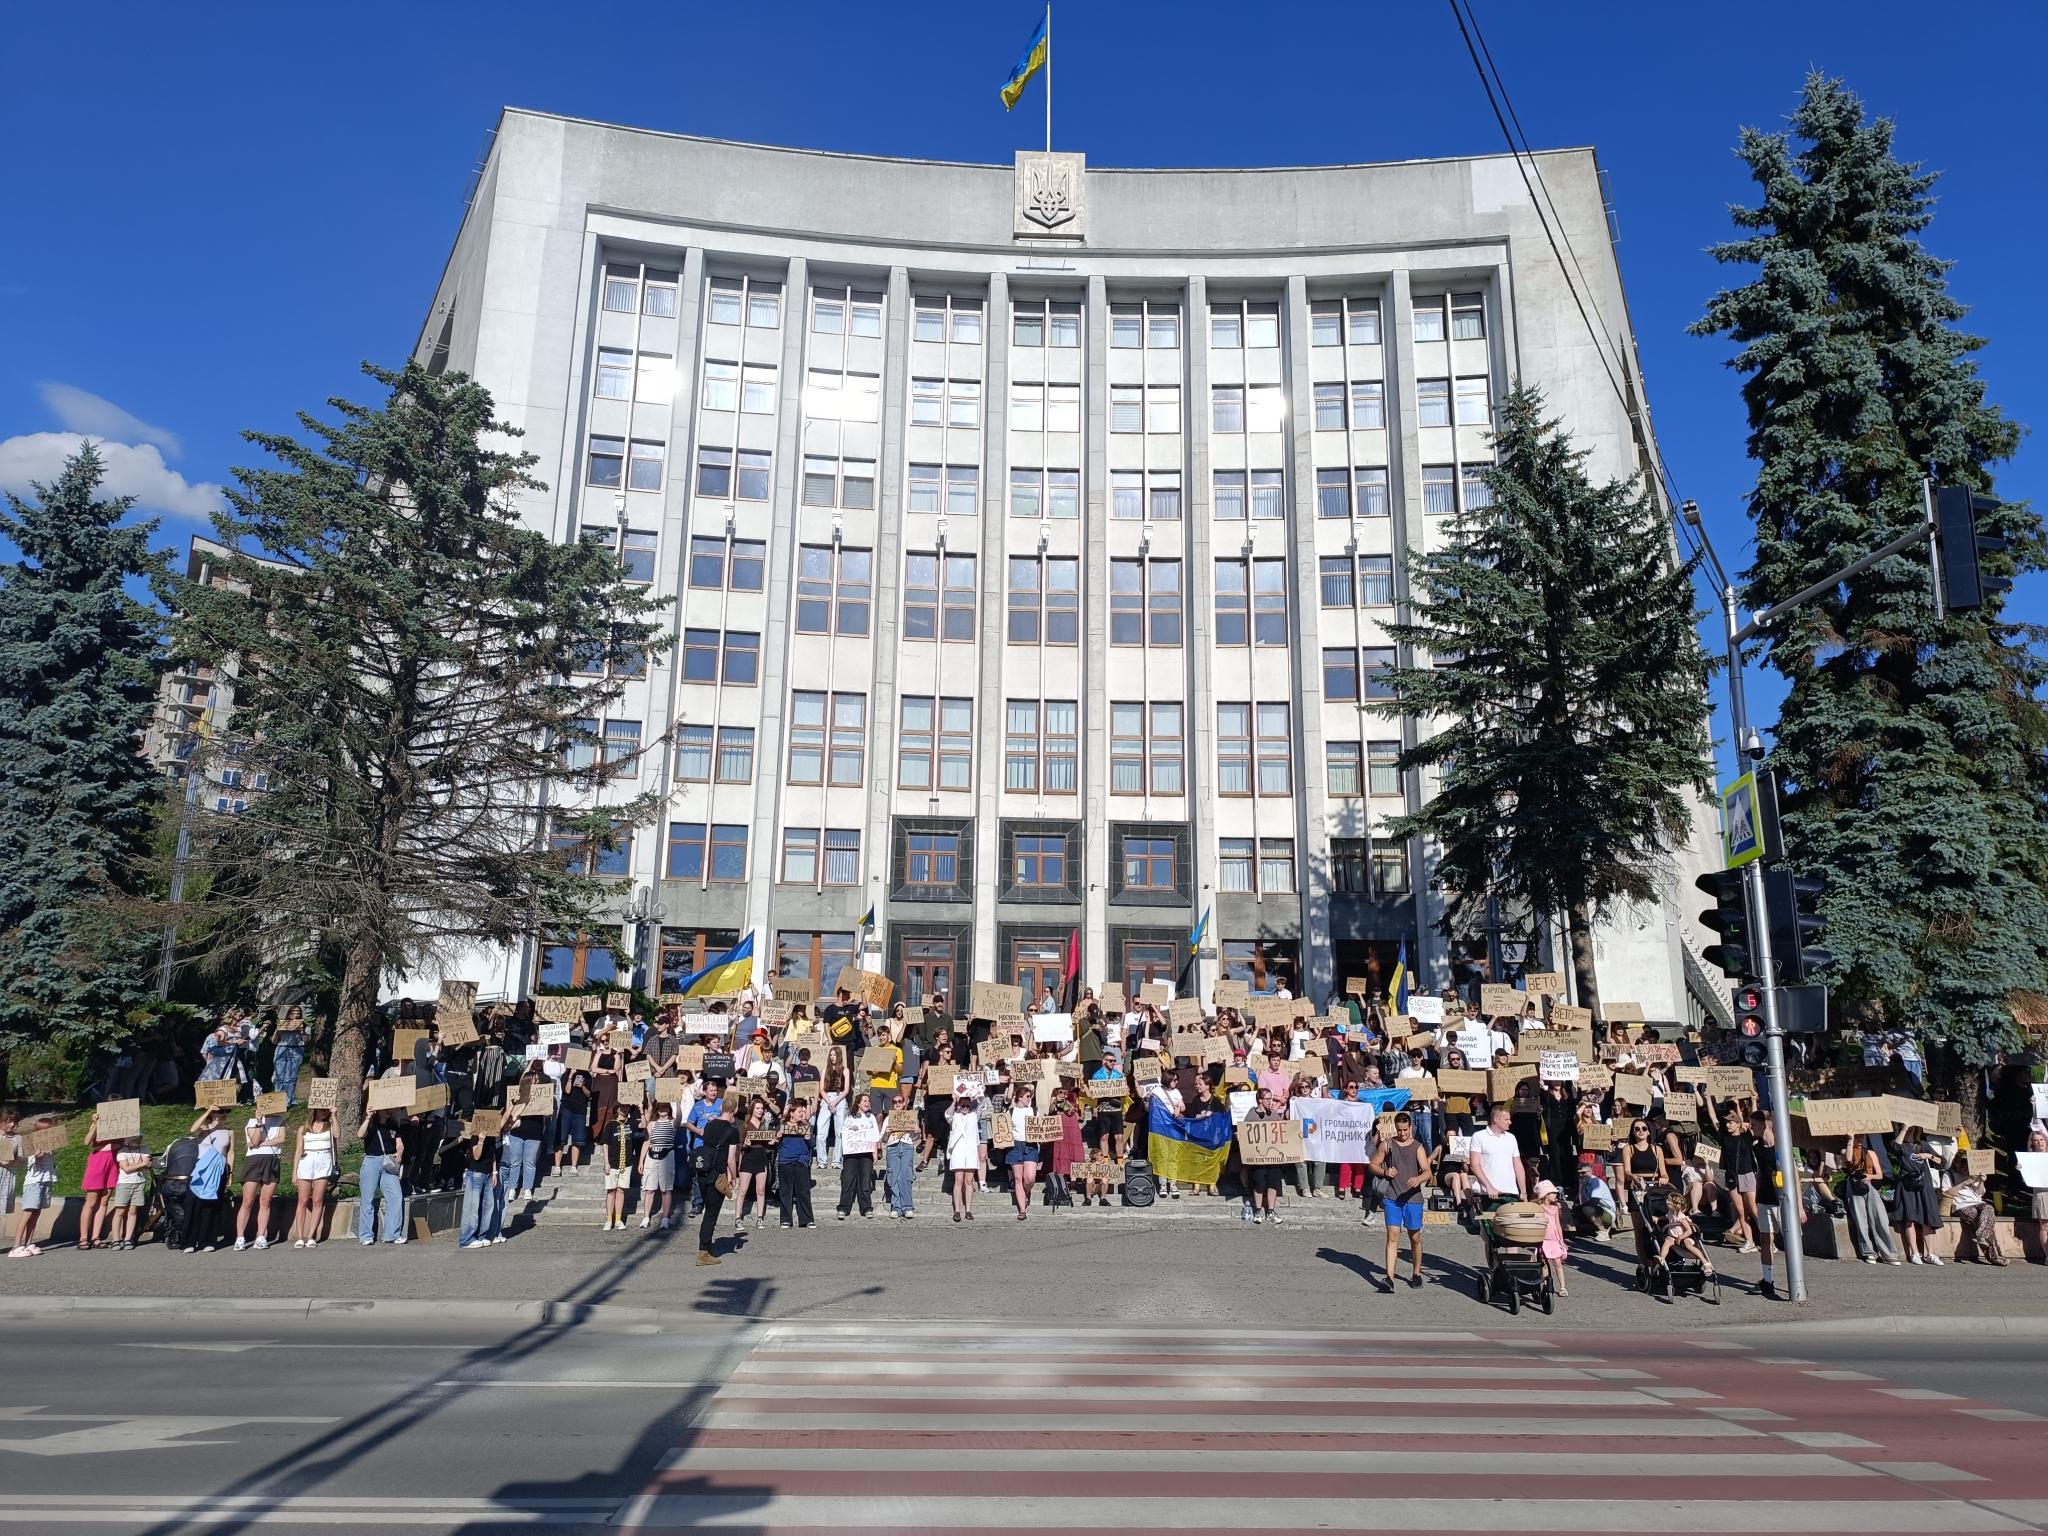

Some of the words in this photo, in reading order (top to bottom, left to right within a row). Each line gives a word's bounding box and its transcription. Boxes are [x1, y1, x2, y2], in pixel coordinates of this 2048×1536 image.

[1528, 975, 1557, 991] ВЕТО
[1746, 994, 1757, 1008] 6
[536, 998, 580, 1016] НАХУЯ
[1484, 1003, 1513, 1012] СМЕРТЬ
[1554, 1006, 1575, 1022] ВЕТО
[311, 1080, 337, 1089] 12414
[1724, 1083, 1751, 1093] НАРОД
[309, 1089, 337, 1098] НОМЕР
[309, 1098, 335, 1107] ЗРАДИ
[1042, 1117, 1056, 1126] ХТО
[1324, 1119, 1371, 1129] ГРОМАДСЬКІ
[1812, 1118, 1890, 1133] ЗАГРОЗОЮ
[783, 1125, 810, 1135] НАБУ
[1324, 1130, 1371, 1144] РАДНИКИ
[1697, 1145, 1718, 1158] 12414
